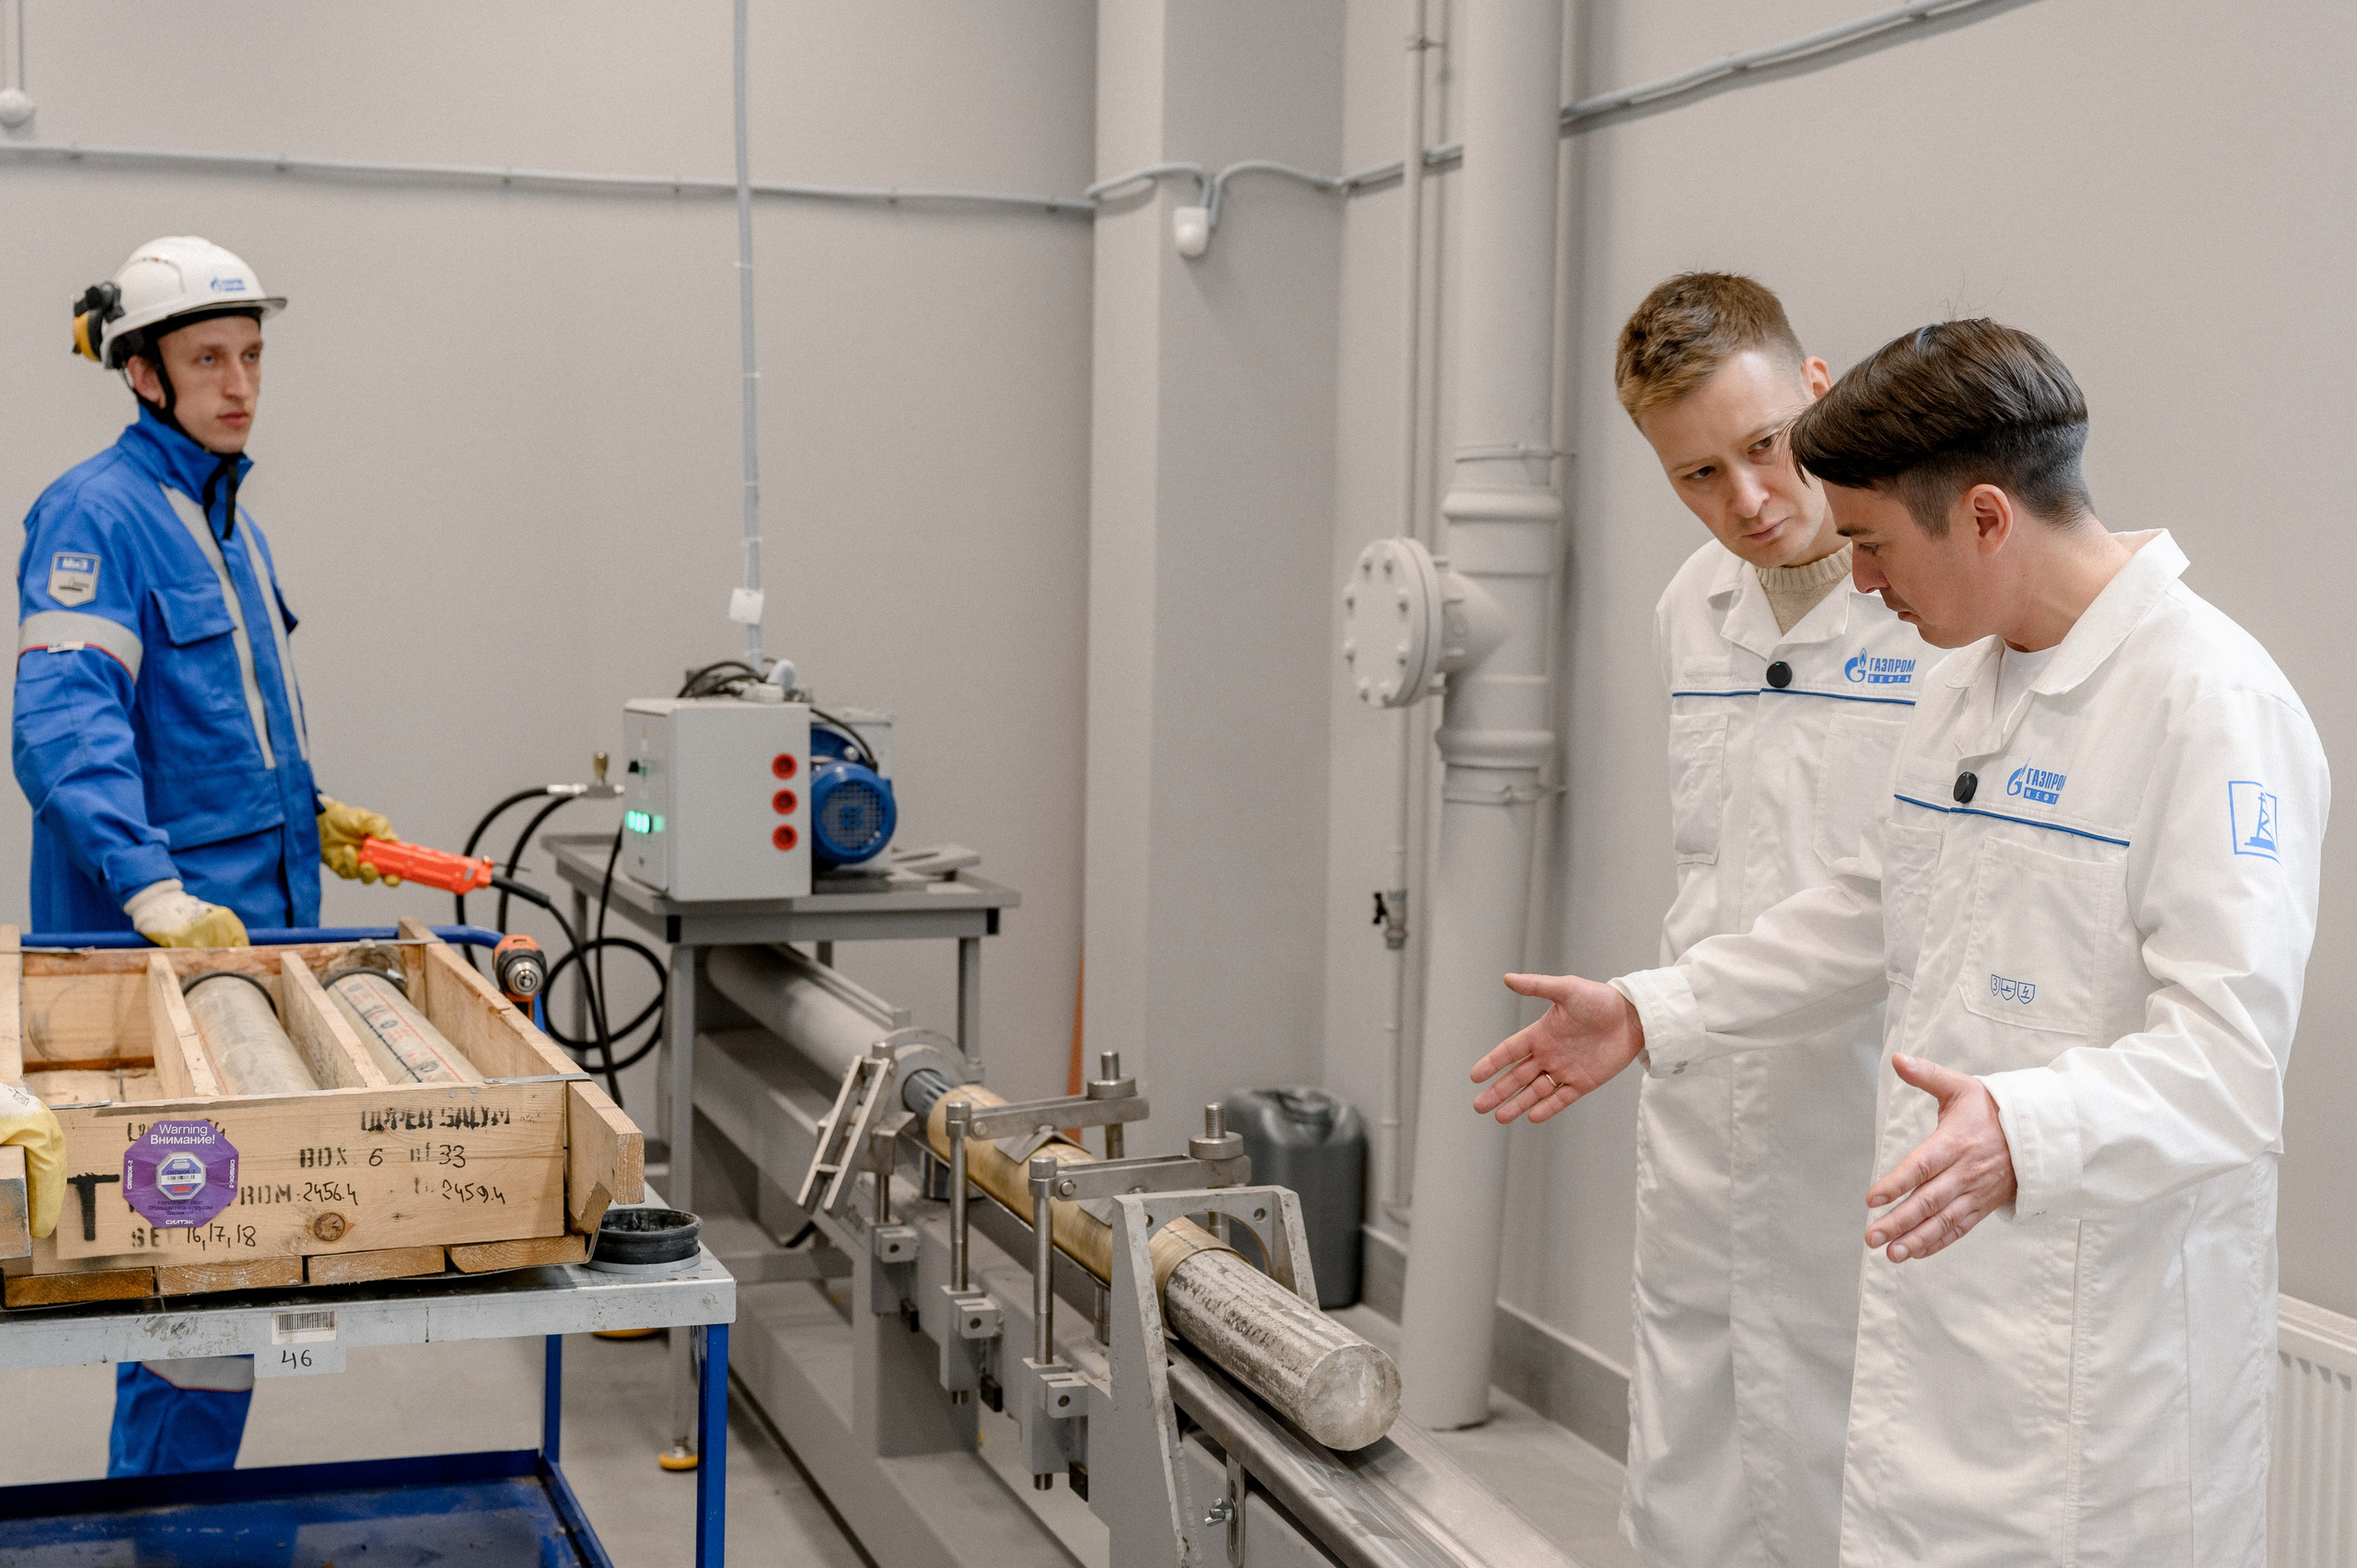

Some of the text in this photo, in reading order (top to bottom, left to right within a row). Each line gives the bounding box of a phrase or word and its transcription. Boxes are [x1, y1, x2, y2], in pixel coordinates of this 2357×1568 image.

[1869, 657, 1916, 672] ГАЗПРОМ
[2026, 767, 2067, 791] ГАЗПРО
[2026, 789, 2057, 803] НЕФТ
[150, 1134, 215, 1144] Внимание!
[159, 1124, 208, 1136] Warning
[299, 1147, 348, 1168] BOX
[368, 1147, 384, 1167] 6
[438, 1144, 467, 1168] 33
[442, 1179, 506, 1205] 2459.4
[281, 1349, 312, 1370] 46
